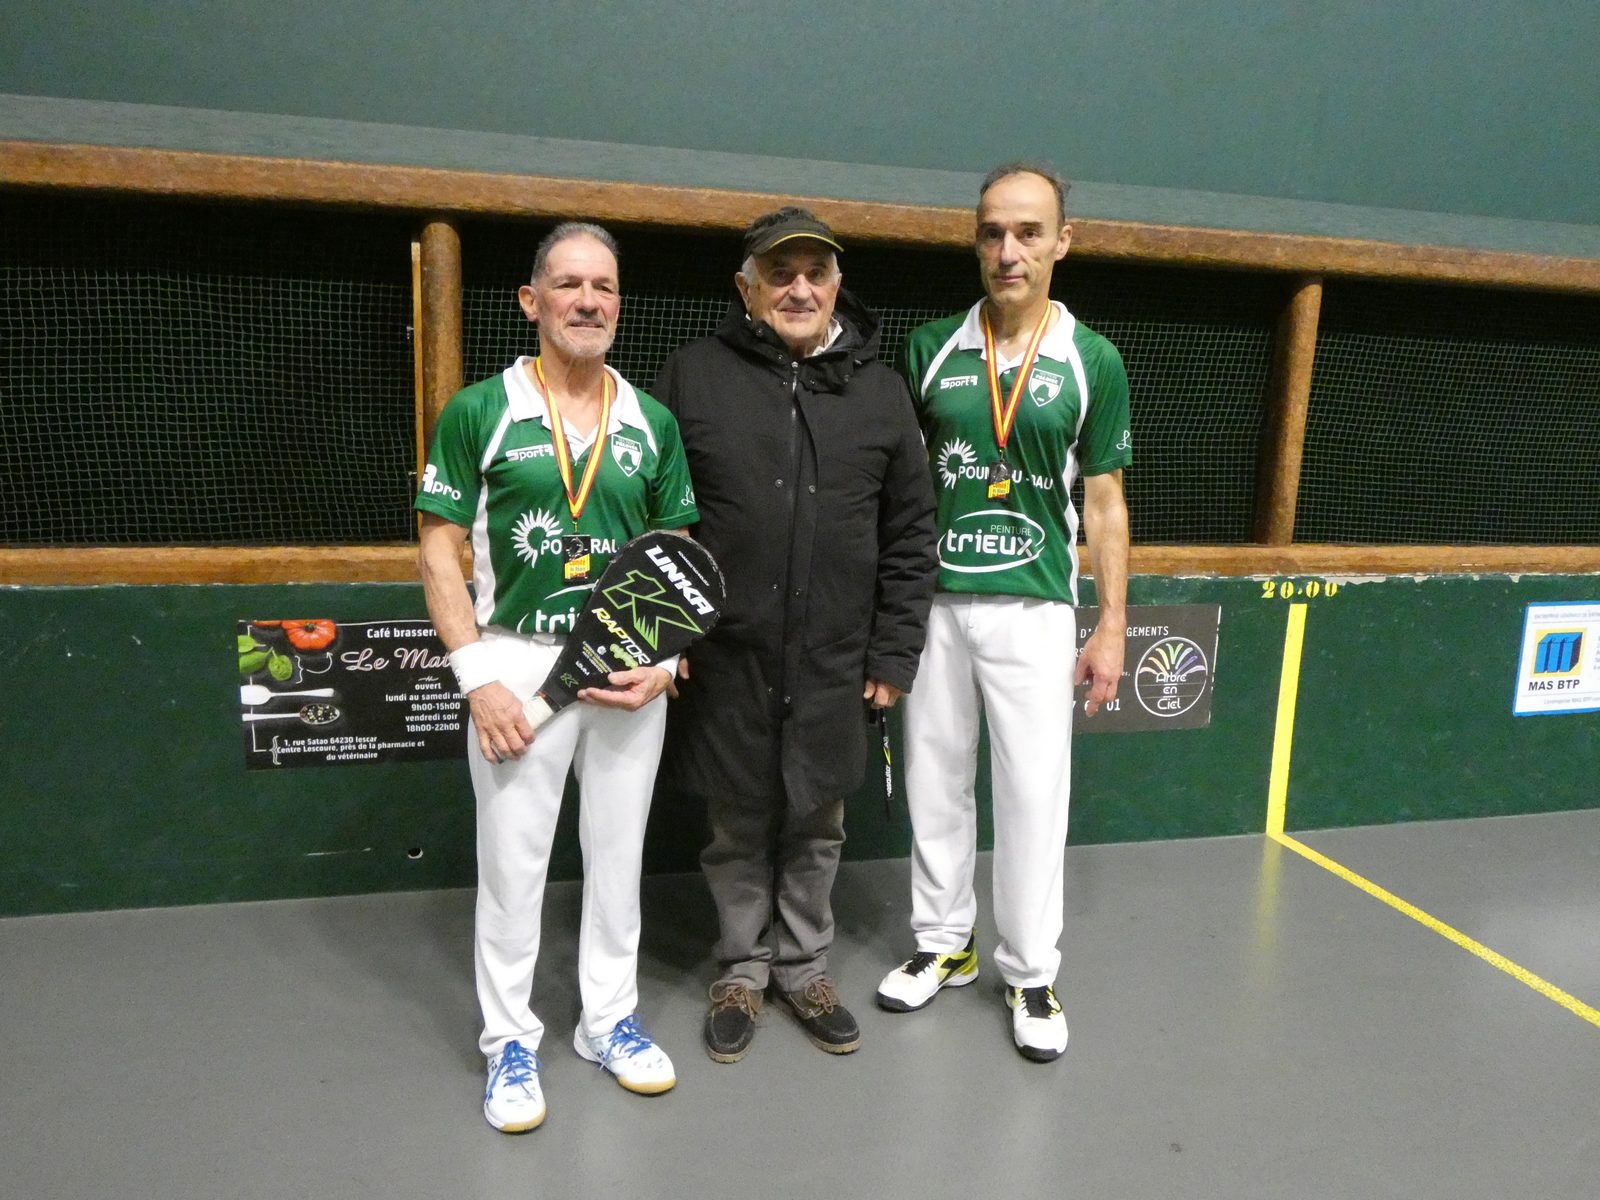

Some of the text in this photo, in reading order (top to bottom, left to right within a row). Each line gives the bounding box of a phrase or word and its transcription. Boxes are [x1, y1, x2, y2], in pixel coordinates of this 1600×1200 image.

[990, 524, 1032, 537] PEINTURE
[1261, 580, 1338, 599] 20.00
[366, 628, 391, 639] Café
[591, 607, 651, 666] RAPTOR
[340, 647, 389, 671] Le
[1155, 671, 1187, 683] Arbre
[414, 682, 442, 691] ouvert
[1528, 679, 1580, 692] MAS BTP
[385, 694, 407, 702] lundi
[421, 692, 451, 701] samedi
[411, 702, 461, 712] 9h00-15h00
[1157, 697, 1181, 710] Ciel
[405, 713, 458, 722] vendredi soir
[406, 723, 460, 733] 18h00-22h00
[329, 737, 354, 745] 64230
[277, 745, 302, 754] Centre
[340, 743, 357, 752] près
[357, 742, 367, 750] de
[377, 740, 416, 750] pharmacie
[337, 751, 378, 760] vétérinaire
